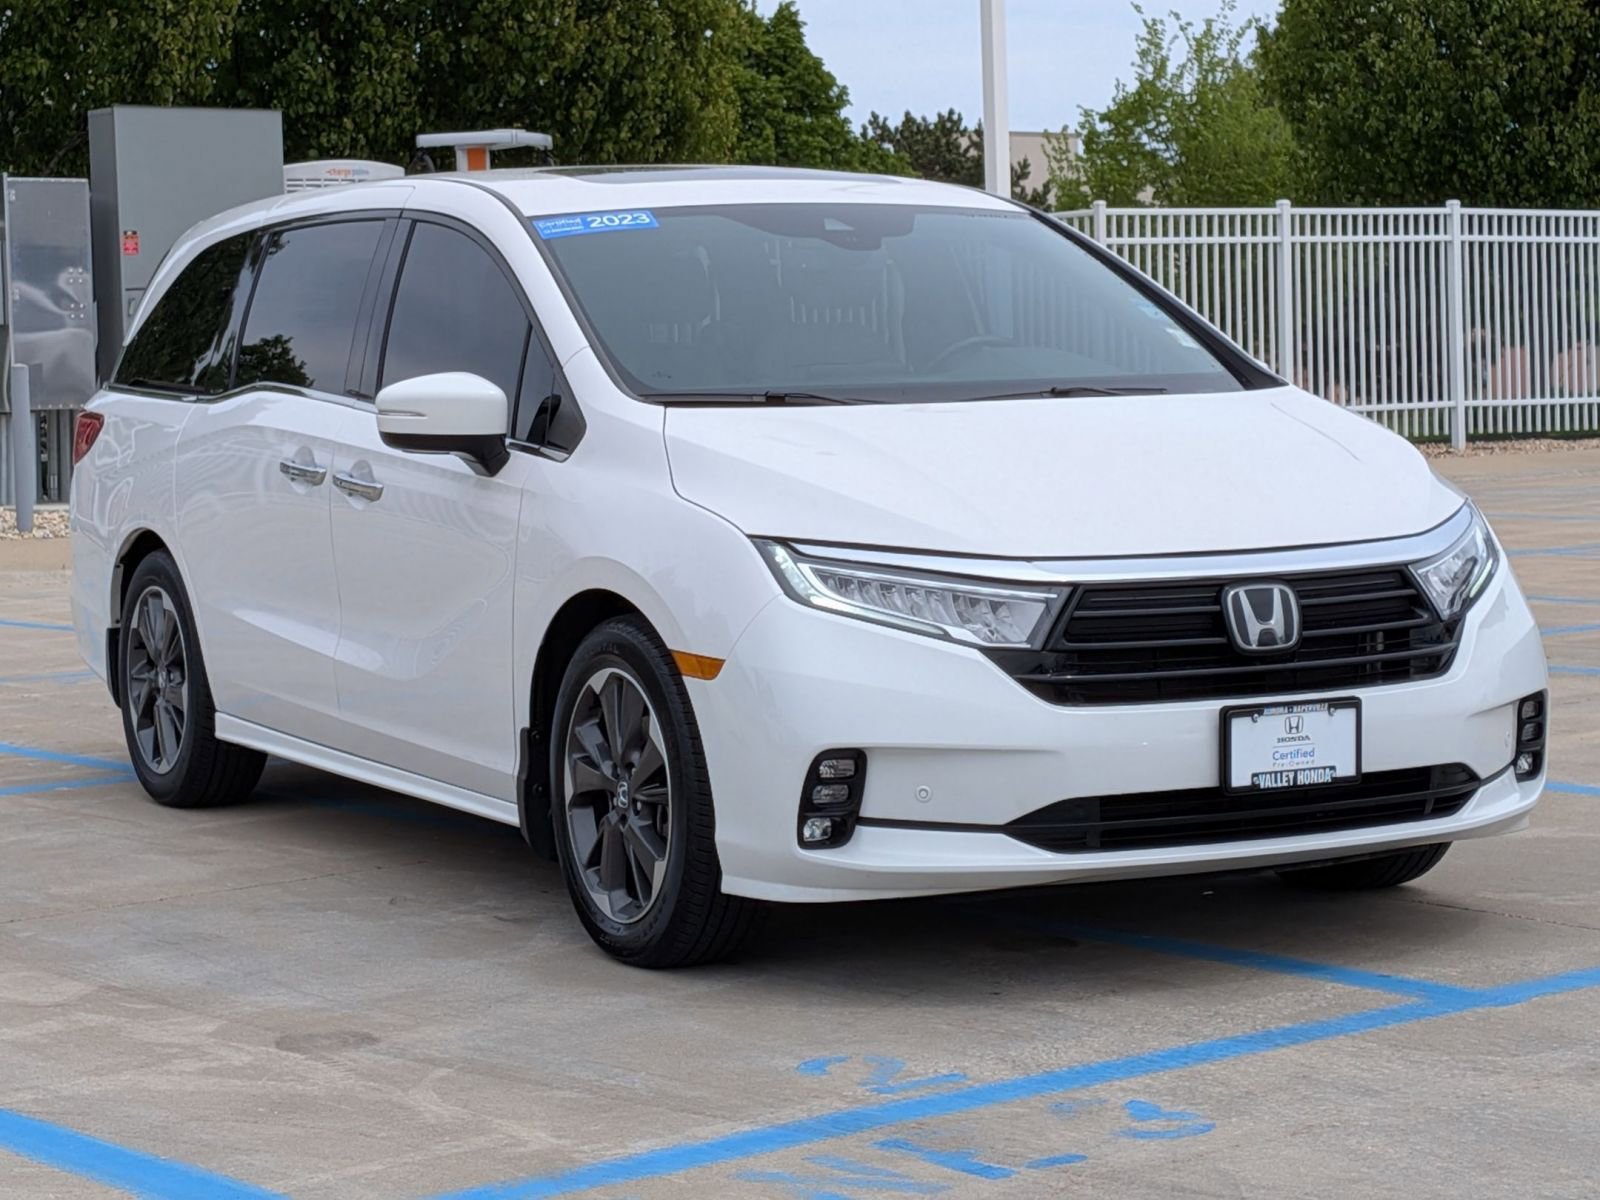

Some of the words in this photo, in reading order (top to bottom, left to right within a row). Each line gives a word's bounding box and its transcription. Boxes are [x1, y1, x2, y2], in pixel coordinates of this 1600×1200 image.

[586, 213, 651, 228] 2023
[1276, 735, 1311, 743] HONDA
[1272, 747, 1316, 761] Certified
[1259, 771, 1295, 789] VALLEY
[1297, 767, 1332, 785] HONDA
